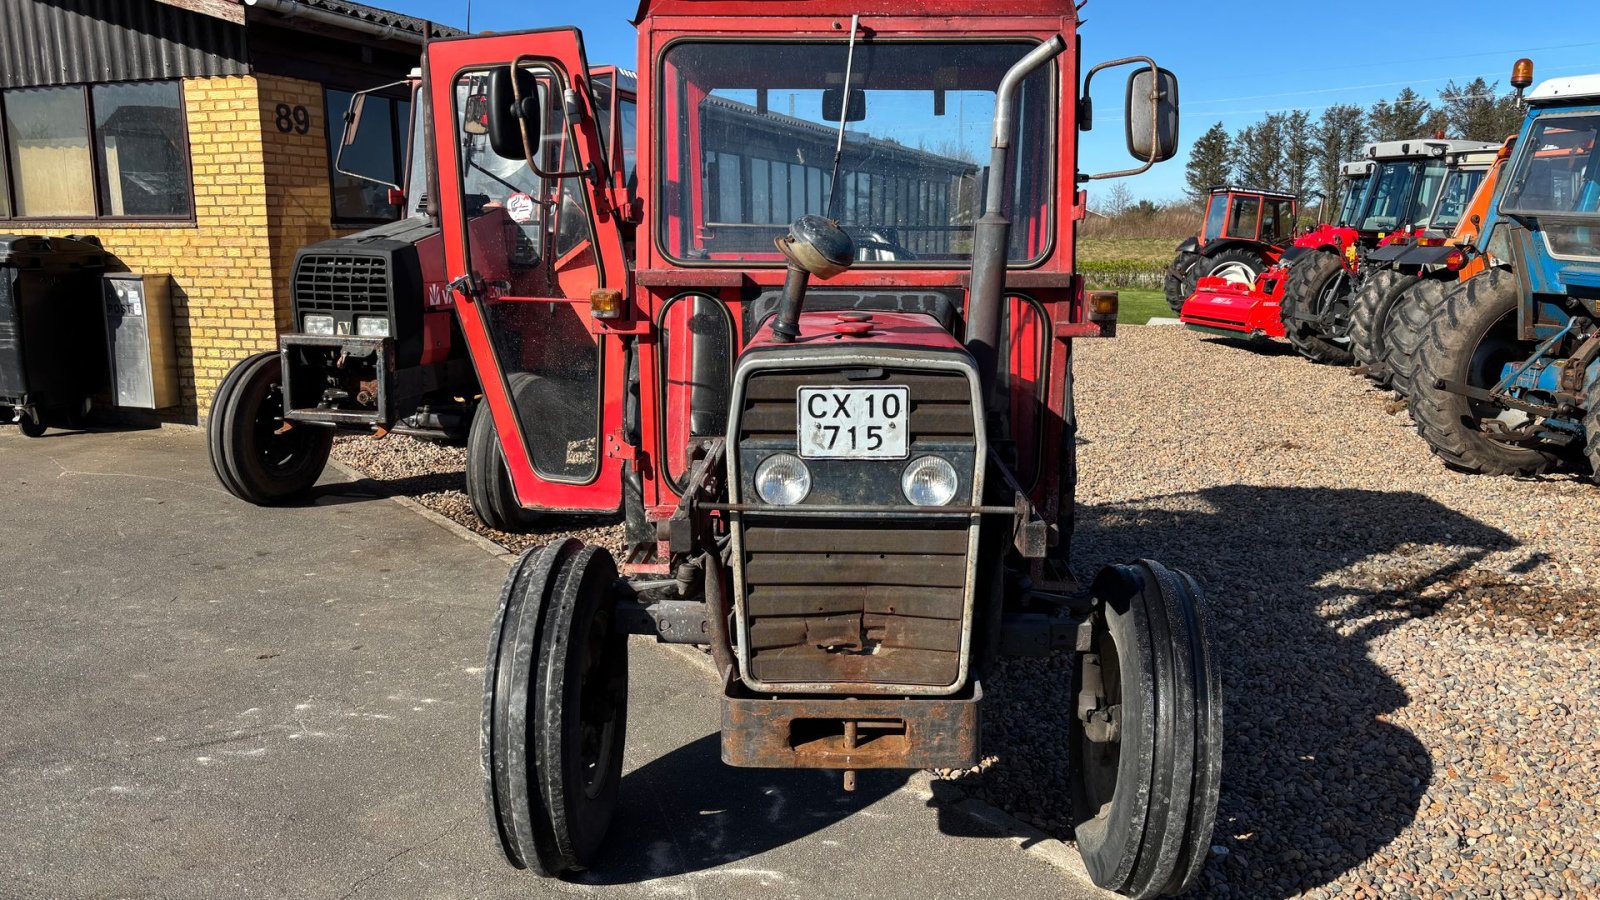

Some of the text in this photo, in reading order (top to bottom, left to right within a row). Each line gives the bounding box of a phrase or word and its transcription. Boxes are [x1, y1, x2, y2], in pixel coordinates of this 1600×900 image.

[276, 103, 310, 135] 89
[107, 303, 132, 314] POST
[807, 393, 900, 418] CX 10
[823, 425, 883, 451] 715
